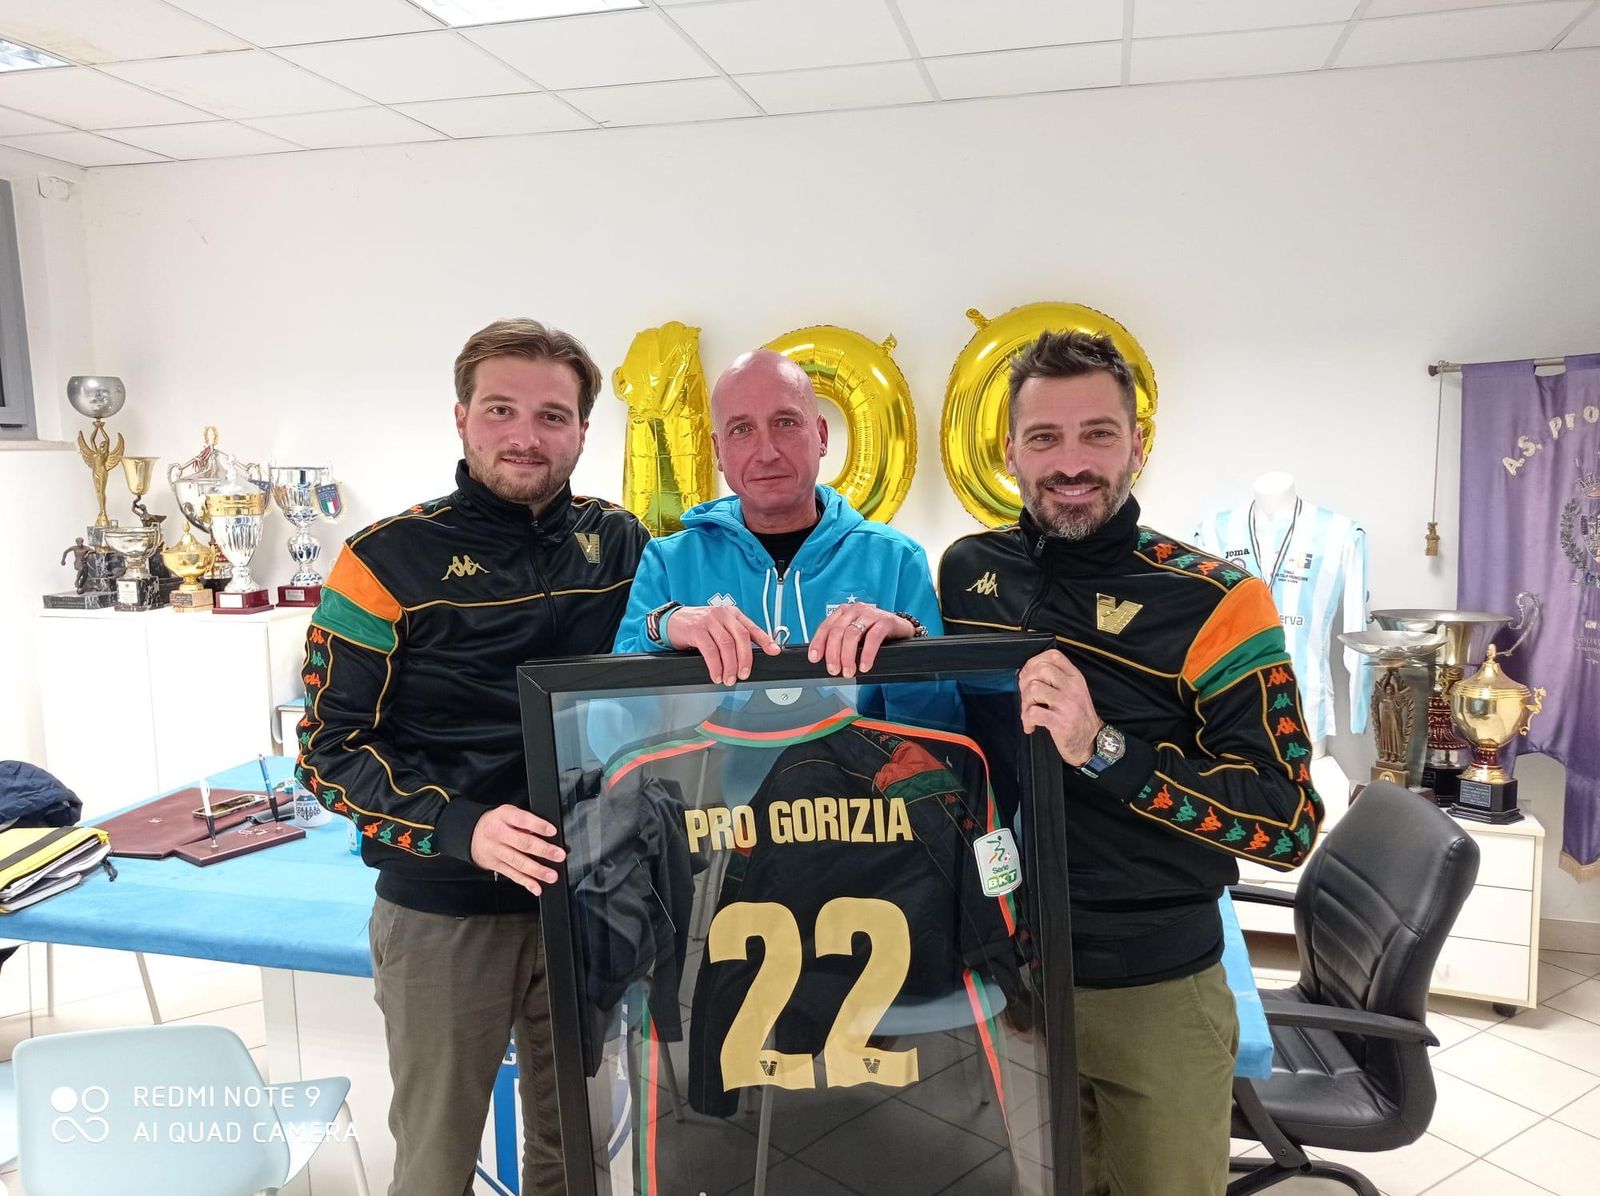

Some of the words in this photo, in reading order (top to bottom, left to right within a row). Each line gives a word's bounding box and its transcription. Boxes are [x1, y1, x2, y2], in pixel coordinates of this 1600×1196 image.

[1279, 614, 1304, 626] erva
[684, 805, 757, 853] PRO
[769, 797, 914, 844] GORIZIA
[988, 869, 1017, 890] BKT
[708, 896, 920, 1092] 22
